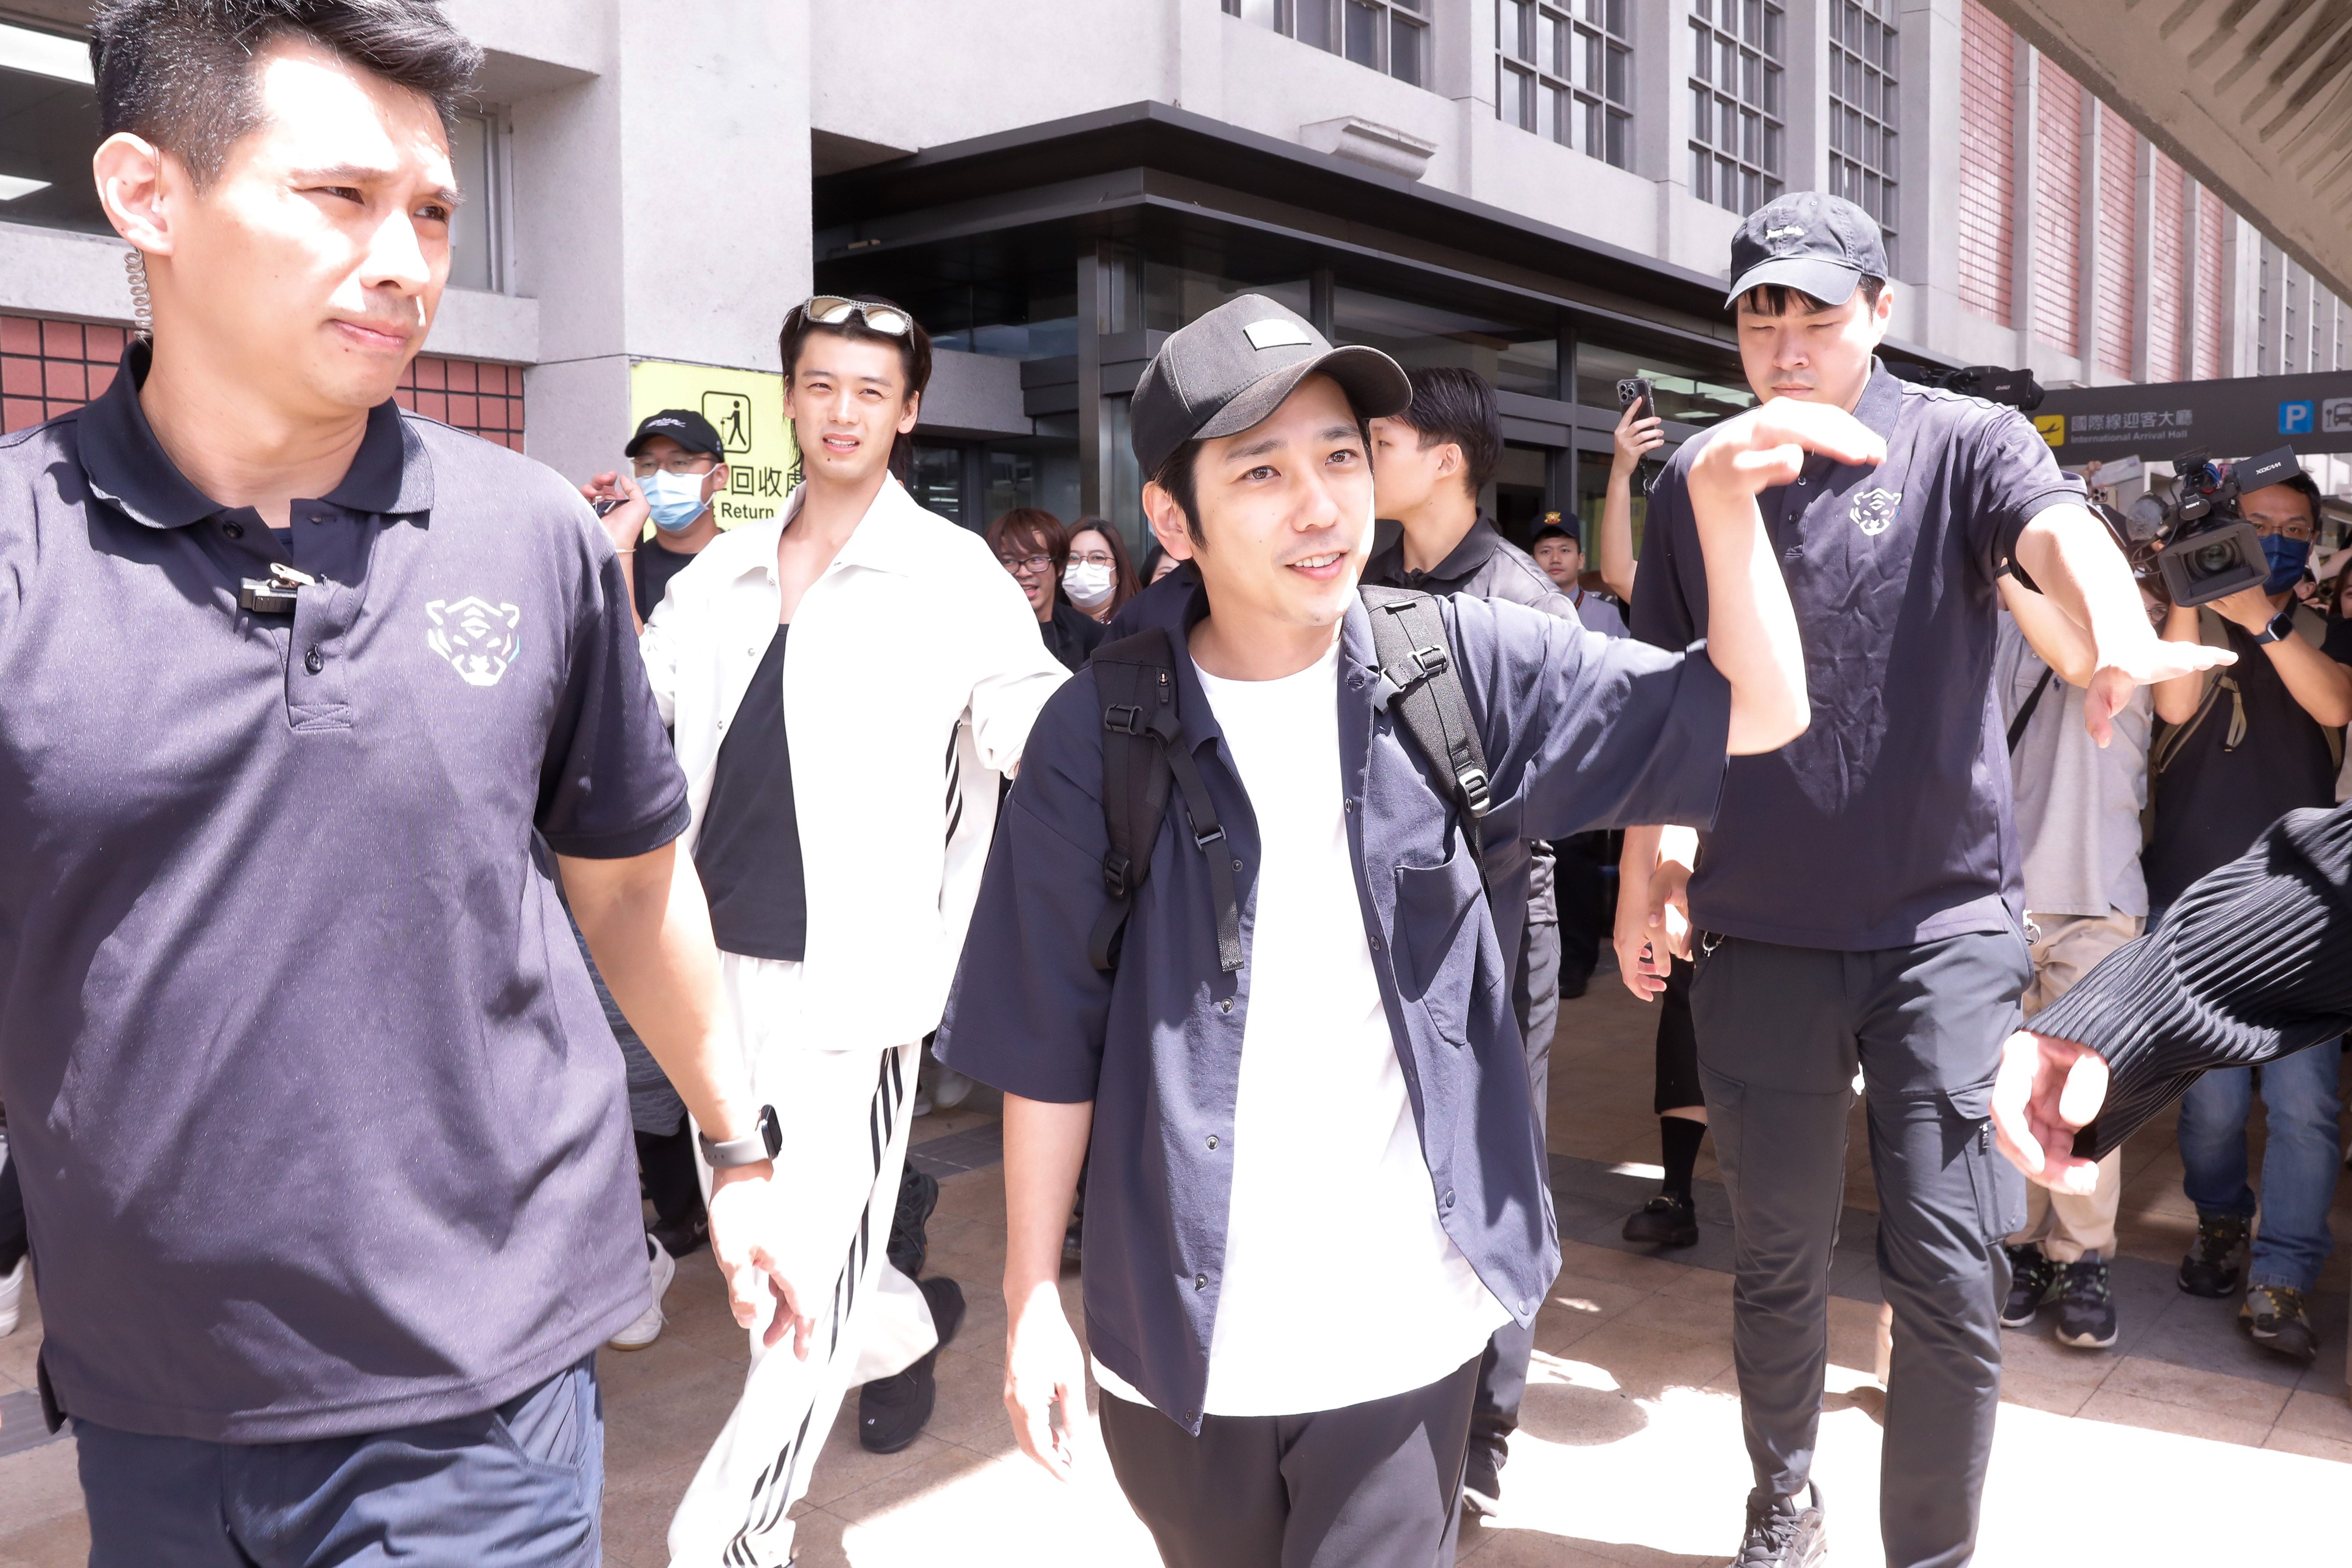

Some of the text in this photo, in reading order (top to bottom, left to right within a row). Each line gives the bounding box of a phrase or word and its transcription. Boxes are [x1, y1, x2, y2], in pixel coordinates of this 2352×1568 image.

[2286, 404, 2306, 430] P
[2071, 429, 2188, 444] International Arrival Hall
[721, 502, 774, 519] Return
